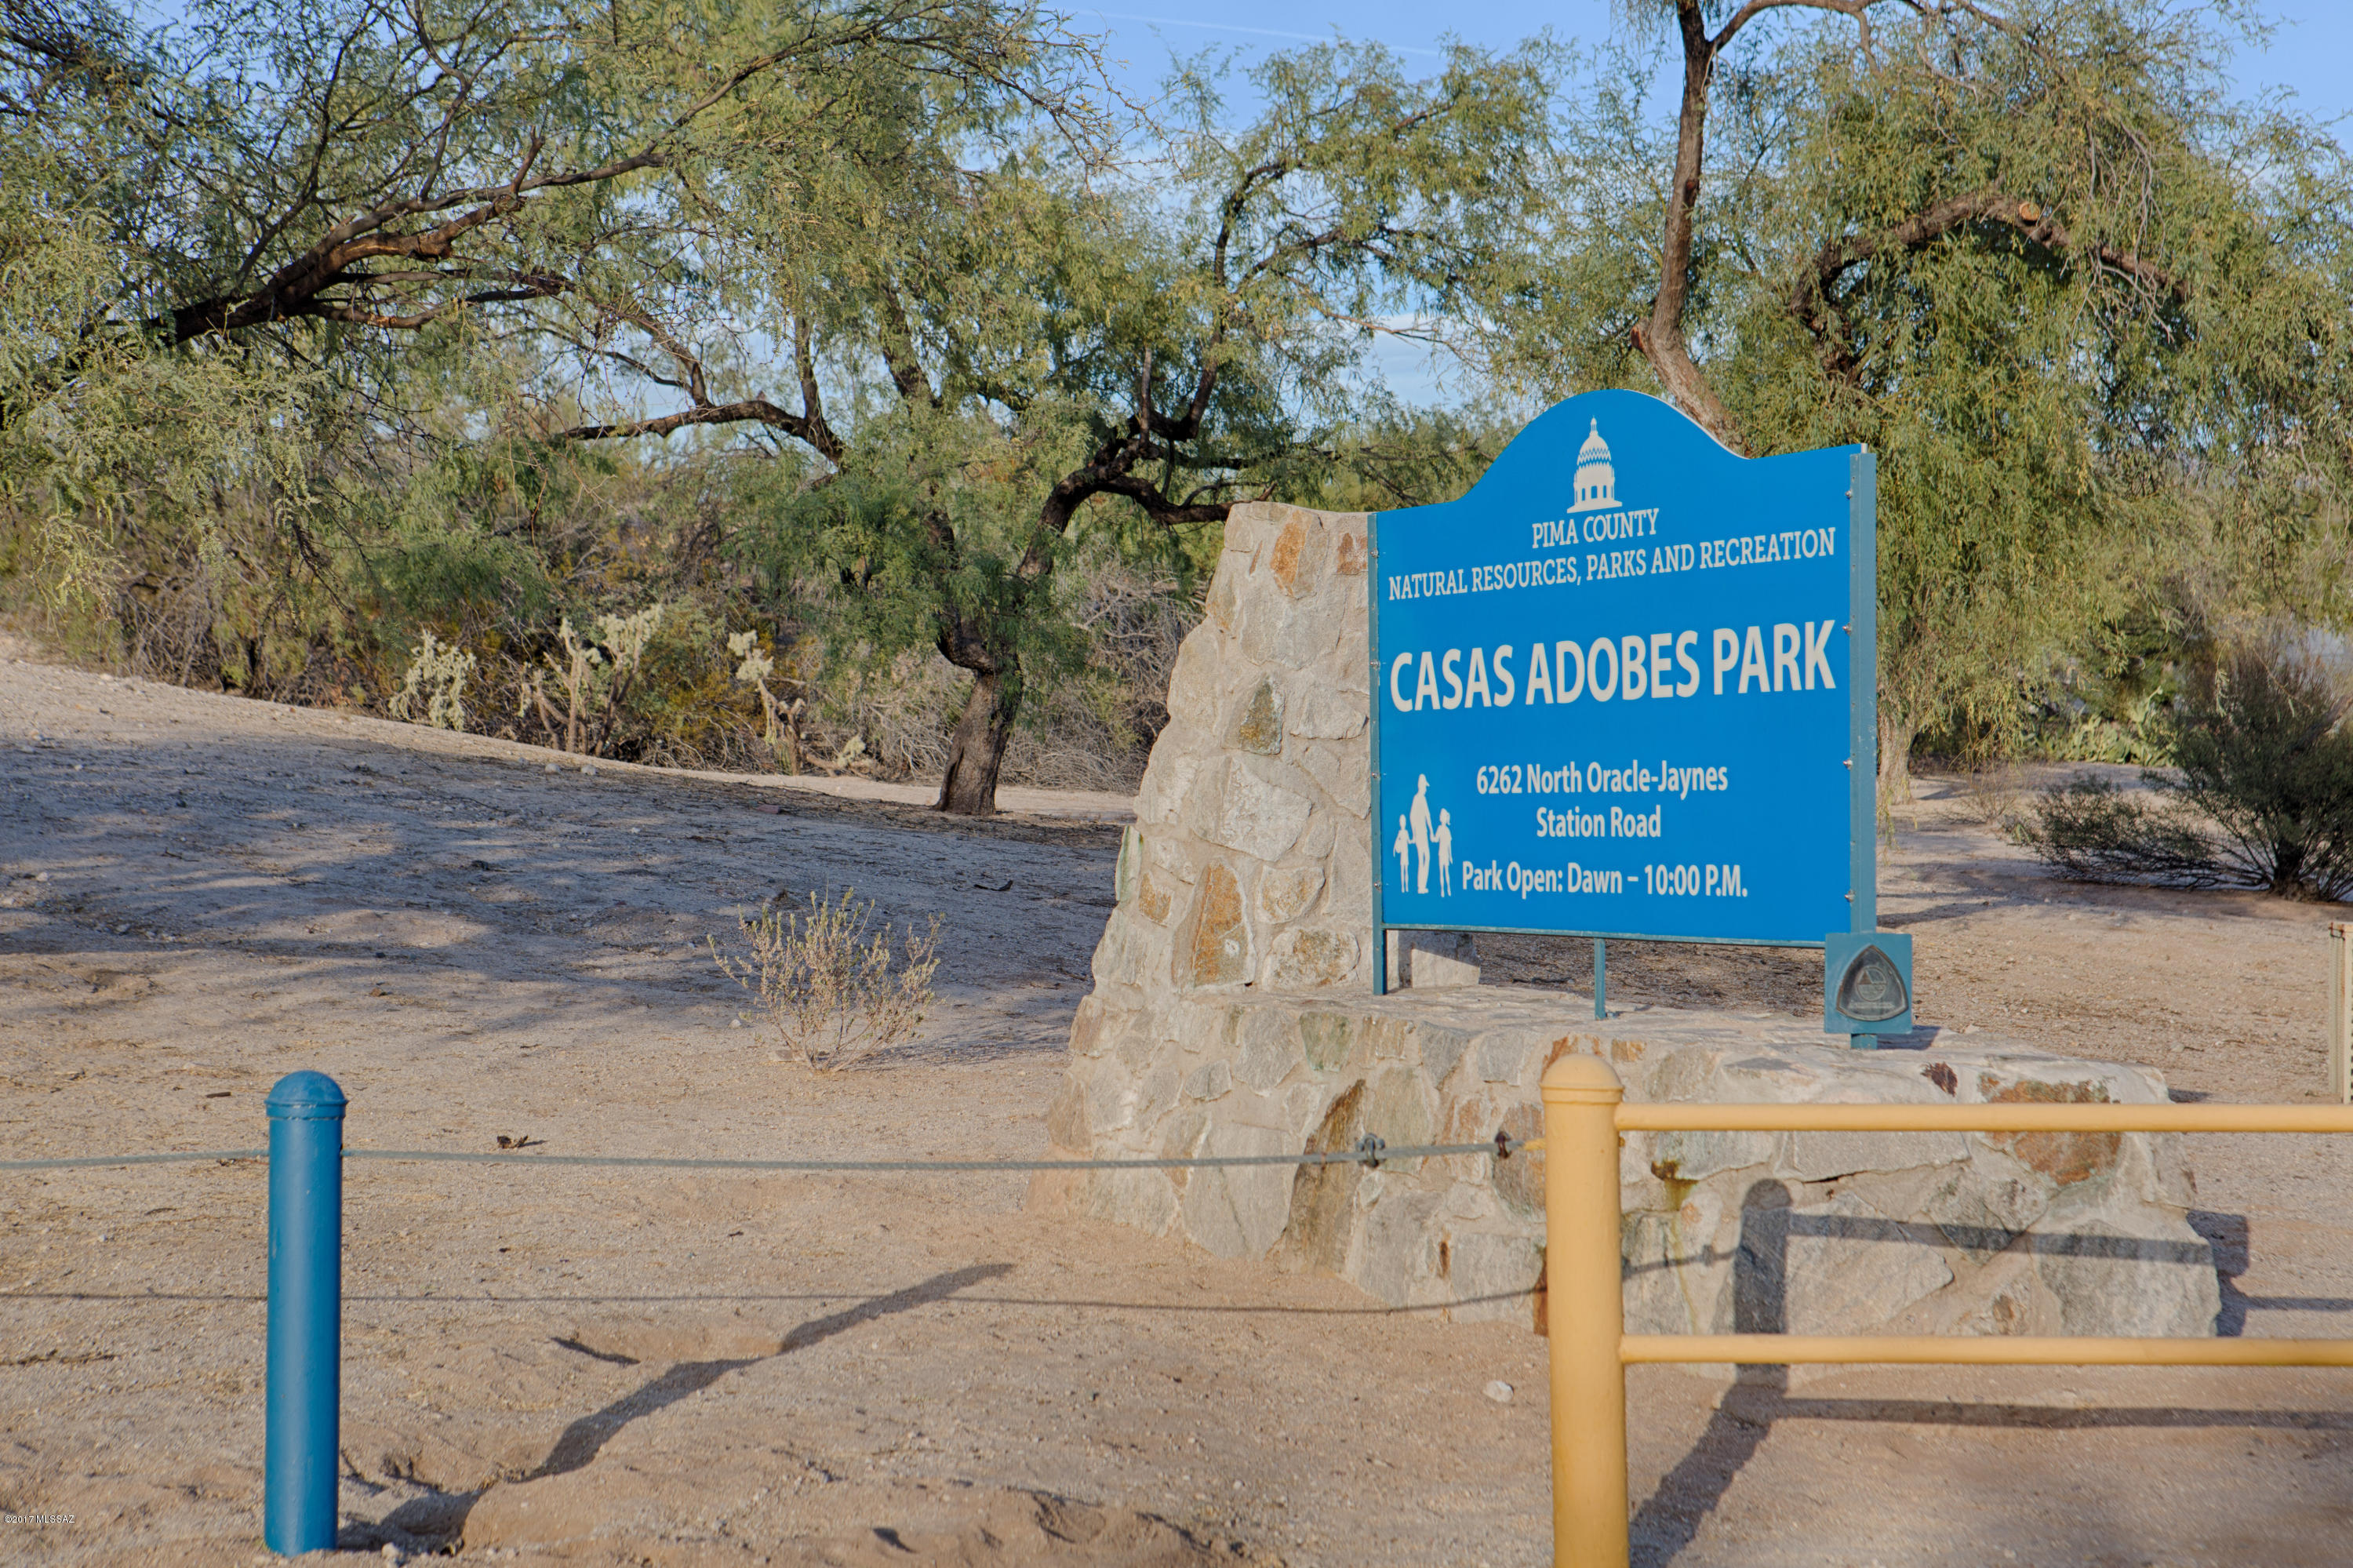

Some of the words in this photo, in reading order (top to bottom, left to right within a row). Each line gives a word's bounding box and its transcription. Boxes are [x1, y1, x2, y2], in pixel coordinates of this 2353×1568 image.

[1533, 519, 1578, 548] PIMA
[1584, 508, 1659, 542] COUNTY
[1389, 569, 1467, 600] NATURAL
[1472, 557, 1580, 591] RESOURCES,
[1587, 549, 1646, 580] PARKS
[1651, 544, 1694, 573] AND
[1700, 527, 1835, 569] RECREATION
[1391, 645, 1515, 711] CASAS
[1526, 631, 1699, 704] ADOBES
[1714, 620, 1835, 694] PARK
[1477, 766, 1522, 794] 6262
[1528, 762, 1581, 793] North
[1587, 760, 1727, 799] Oracle-Jaynes
[1537, 806, 1605, 837] Station
[1611, 805, 1660, 837] Road
[1463, 860, 1502, 890] Park
[1507, 862, 1562, 899] Open:
[1568, 863, 1621, 893] Dawn
[1645, 864, 1700, 895] 10:00
[1706, 864, 1747, 897] P.M.
